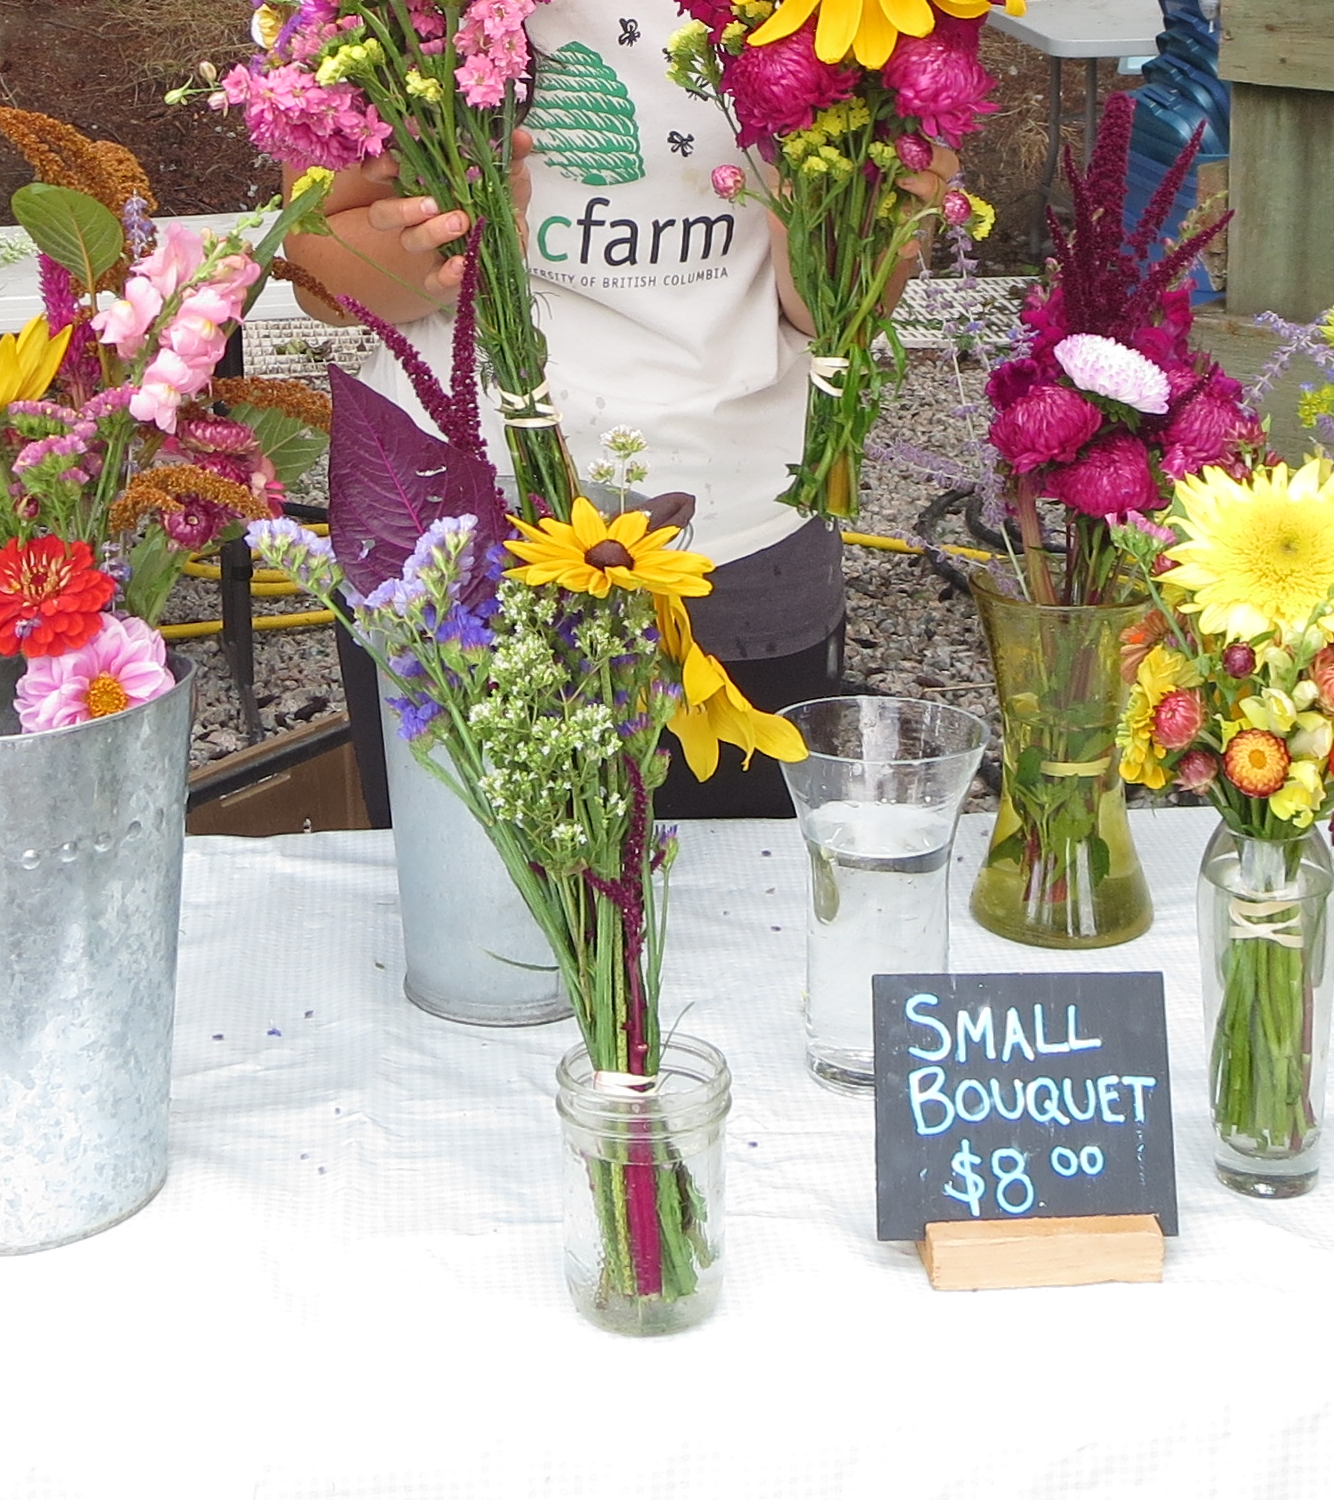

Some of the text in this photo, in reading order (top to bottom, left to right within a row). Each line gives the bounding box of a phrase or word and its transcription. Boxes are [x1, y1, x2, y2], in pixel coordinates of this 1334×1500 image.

[528, 267, 729, 289] ERSITY OF BRITISH COLUMBIA
[908, 1066, 1157, 1135] BOUQUET
